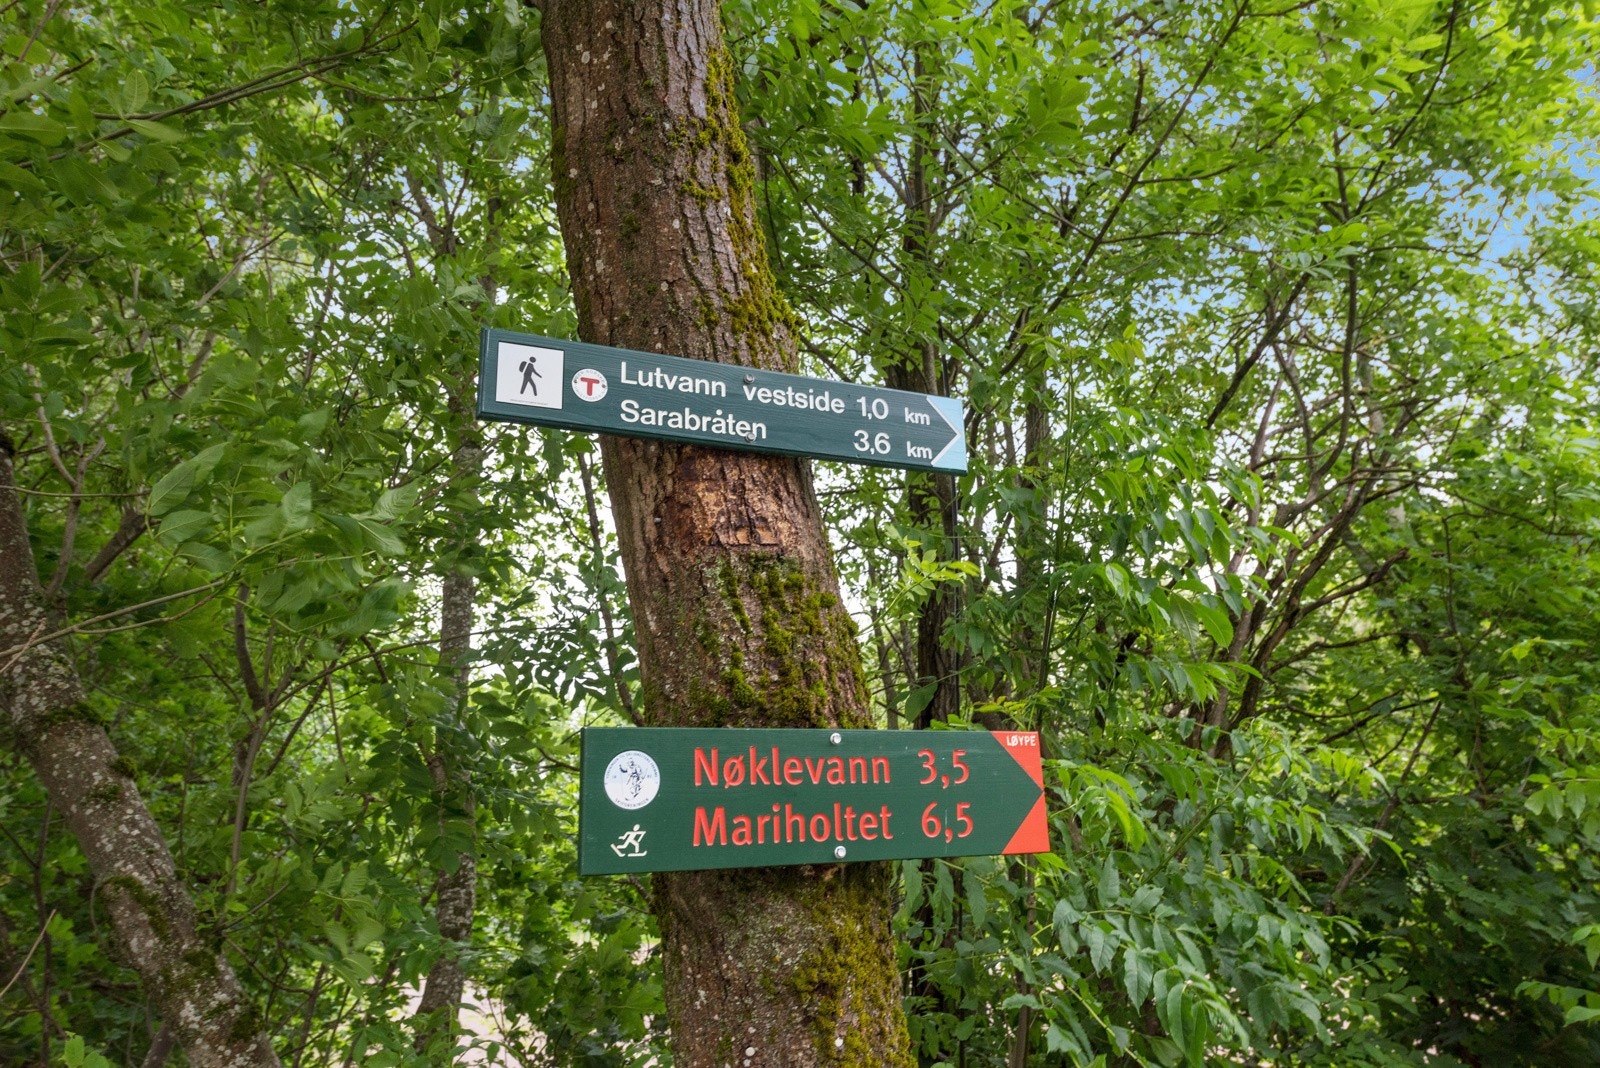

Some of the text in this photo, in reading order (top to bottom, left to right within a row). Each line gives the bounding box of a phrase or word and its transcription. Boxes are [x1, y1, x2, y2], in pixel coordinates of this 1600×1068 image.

[580, 377, 600, 397] T
[621, 361, 727, 398] Lutvann
[742, 384, 846, 414] vestside
[855, 395, 890, 421] 1,0
[904, 406, 931, 426] km
[620, 399, 933, 460] Sarabråten 3,6 km
[1006, 735, 1036, 747] LØYPE
[694, 745, 891, 789] Nøklevann
[917, 749, 970, 789] 3,5
[693, 801, 974, 847] Mariholtet 6,5
